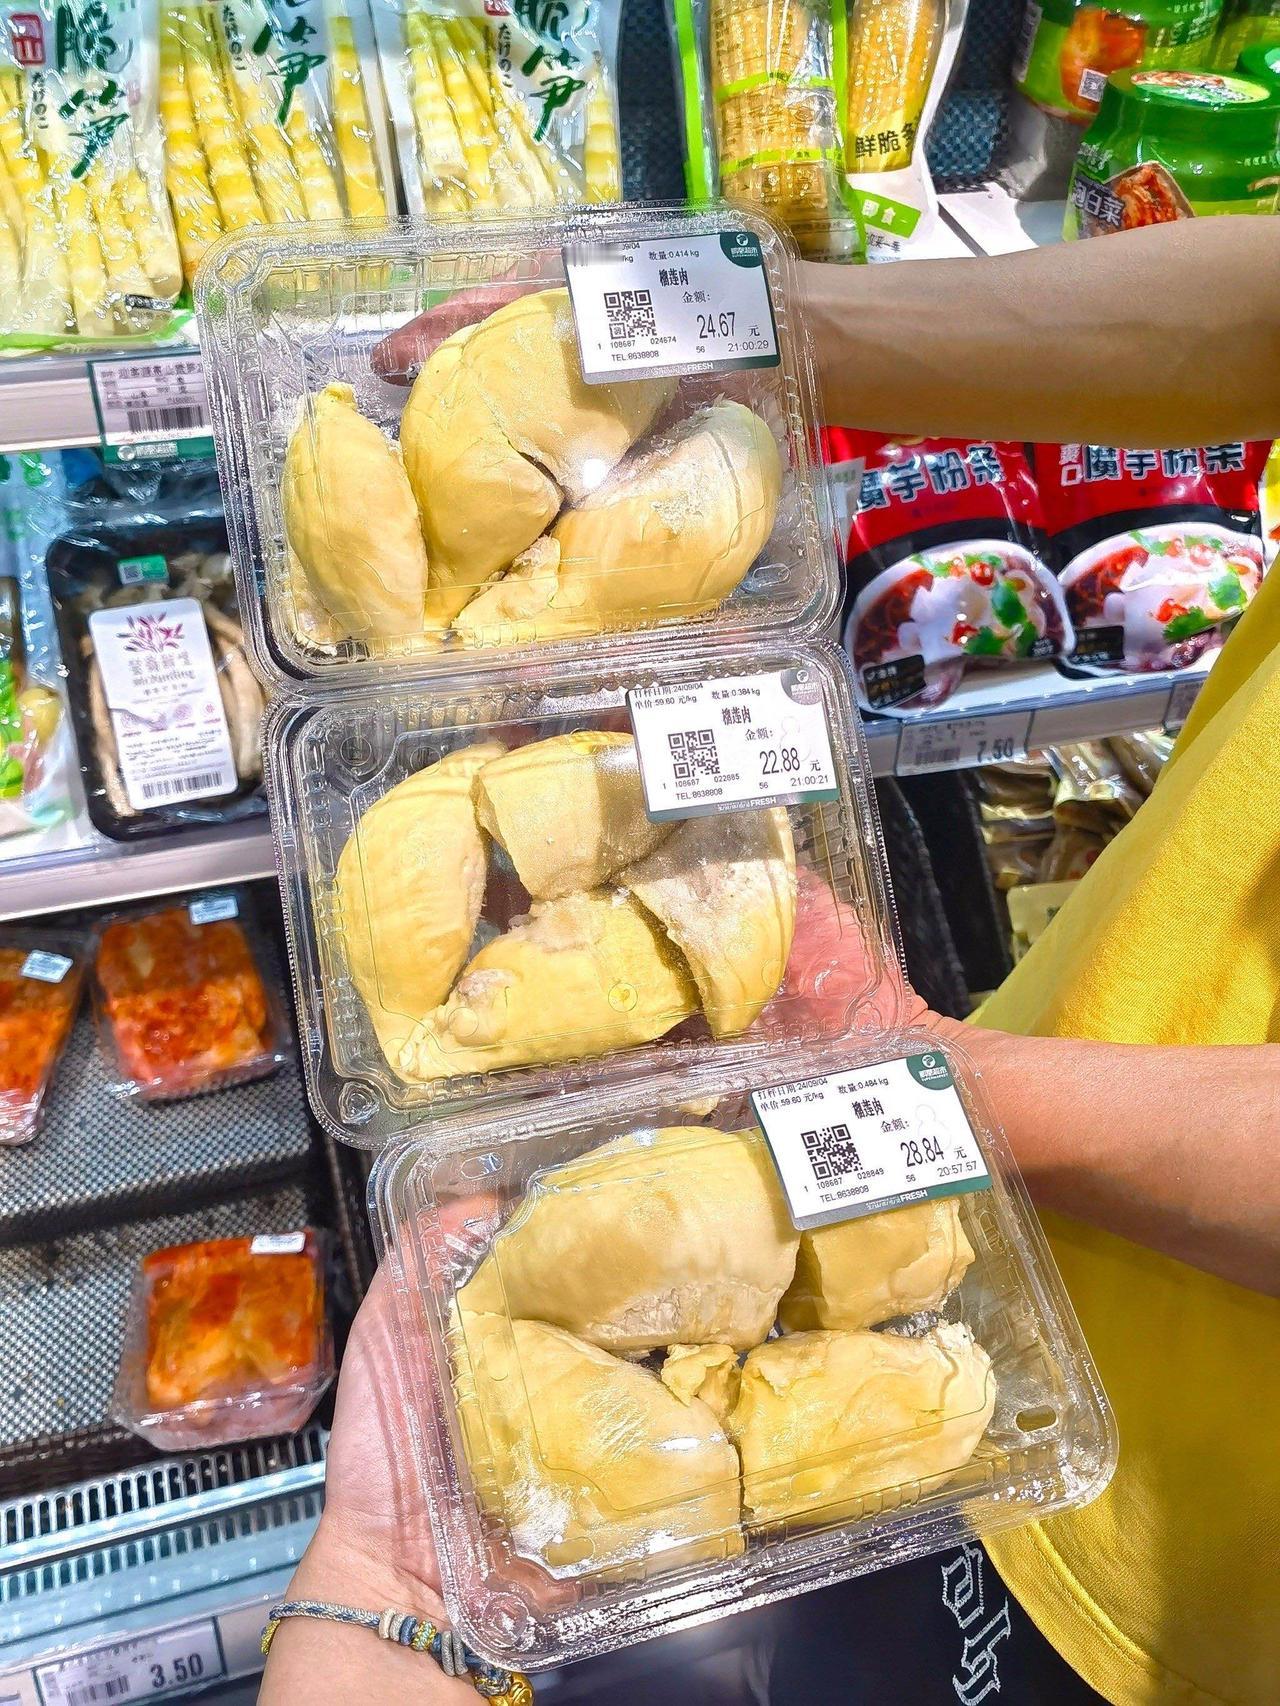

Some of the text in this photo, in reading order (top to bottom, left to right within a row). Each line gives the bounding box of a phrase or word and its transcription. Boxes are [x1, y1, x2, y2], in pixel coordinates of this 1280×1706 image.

[498, 22, 513, 88] たけのこ
[690, 250, 700, 260] kg
[658, 267, 690, 288] 榴莲肉
[682, 290, 711, 304] 金额:
[696, 311, 760, 340] 24.67 元
[695, 340, 770, 354] 56 21:00:29
[687, 361, 714, 373] FRESH
[721, 705, 752, 726] 榴莲肉
[745, 727, 774, 741] 金额:
[977, 737, 1014, 763] 7.50
[759, 747, 821, 775] 22.88 元
[759, 775, 829, 789] 56 21:00:21
[750, 796, 777, 808] FRESH
[851, 1097, 885, 1119] 榴莲肉
[880, 1118, 910, 1134] 金额:
[900, 1135, 967, 1168] 28.84 元
[816, 1177, 843, 1190] 108687
[857, 1167, 885, 1180] 028849
[905, 1160, 978, 1183] 56 20:57:57
[899, 1190, 928, 1203] FRESH
[150, 1652, 204, 1689] 3.50
